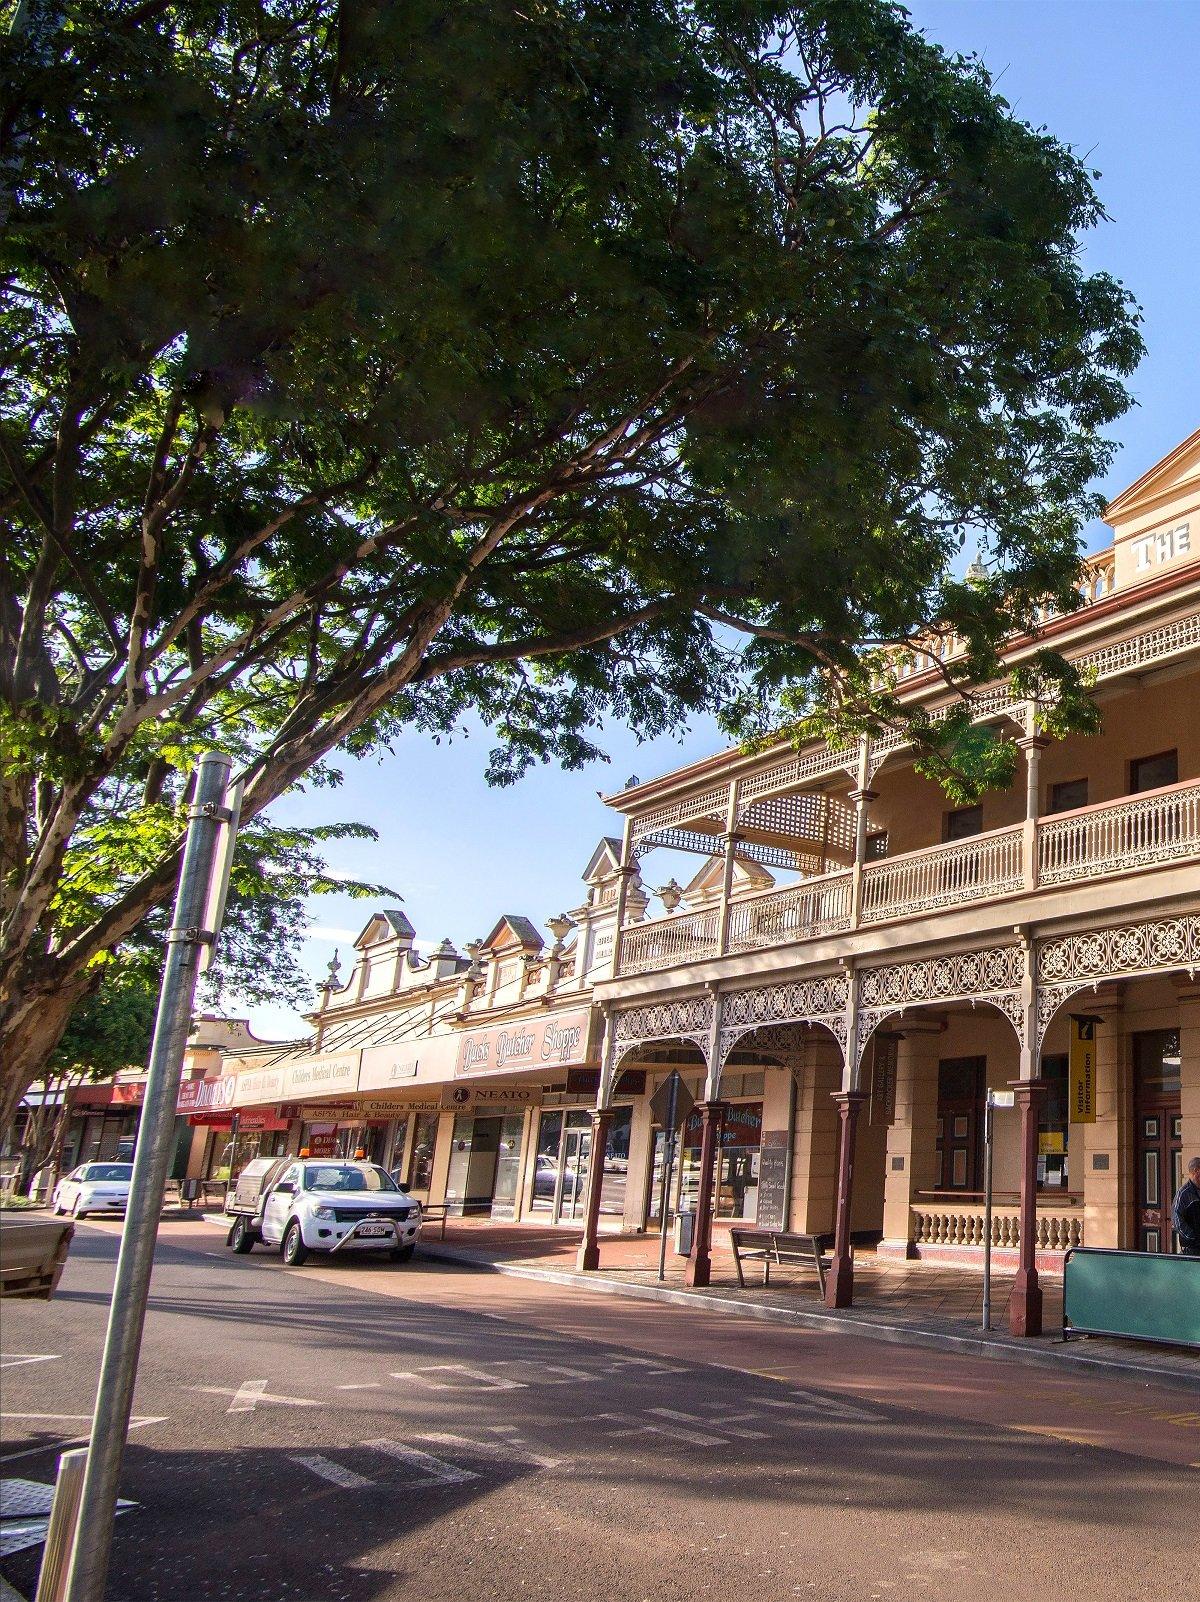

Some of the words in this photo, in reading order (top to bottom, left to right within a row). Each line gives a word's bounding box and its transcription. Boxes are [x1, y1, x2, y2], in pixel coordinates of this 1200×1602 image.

[1131, 525, 1190, 573] THE
[495, 1027, 536, 1067] Butcher
[540, 1020, 581, 1063] Shoppe
[292, 1067, 311, 1084] Childers
[312, 1065, 331, 1080] Medical
[332, 1063, 351, 1079] Centre
[475, 1089, 531, 1100] NEATO
[342, 1110, 361, 1118] Hair
[374, 1111, 401, 1119] Beauty
[370, 1102, 405, 1110] Childers
[407, 1102, 438, 1110] Medical
[727, 1107, 761, 1128] Butcher
